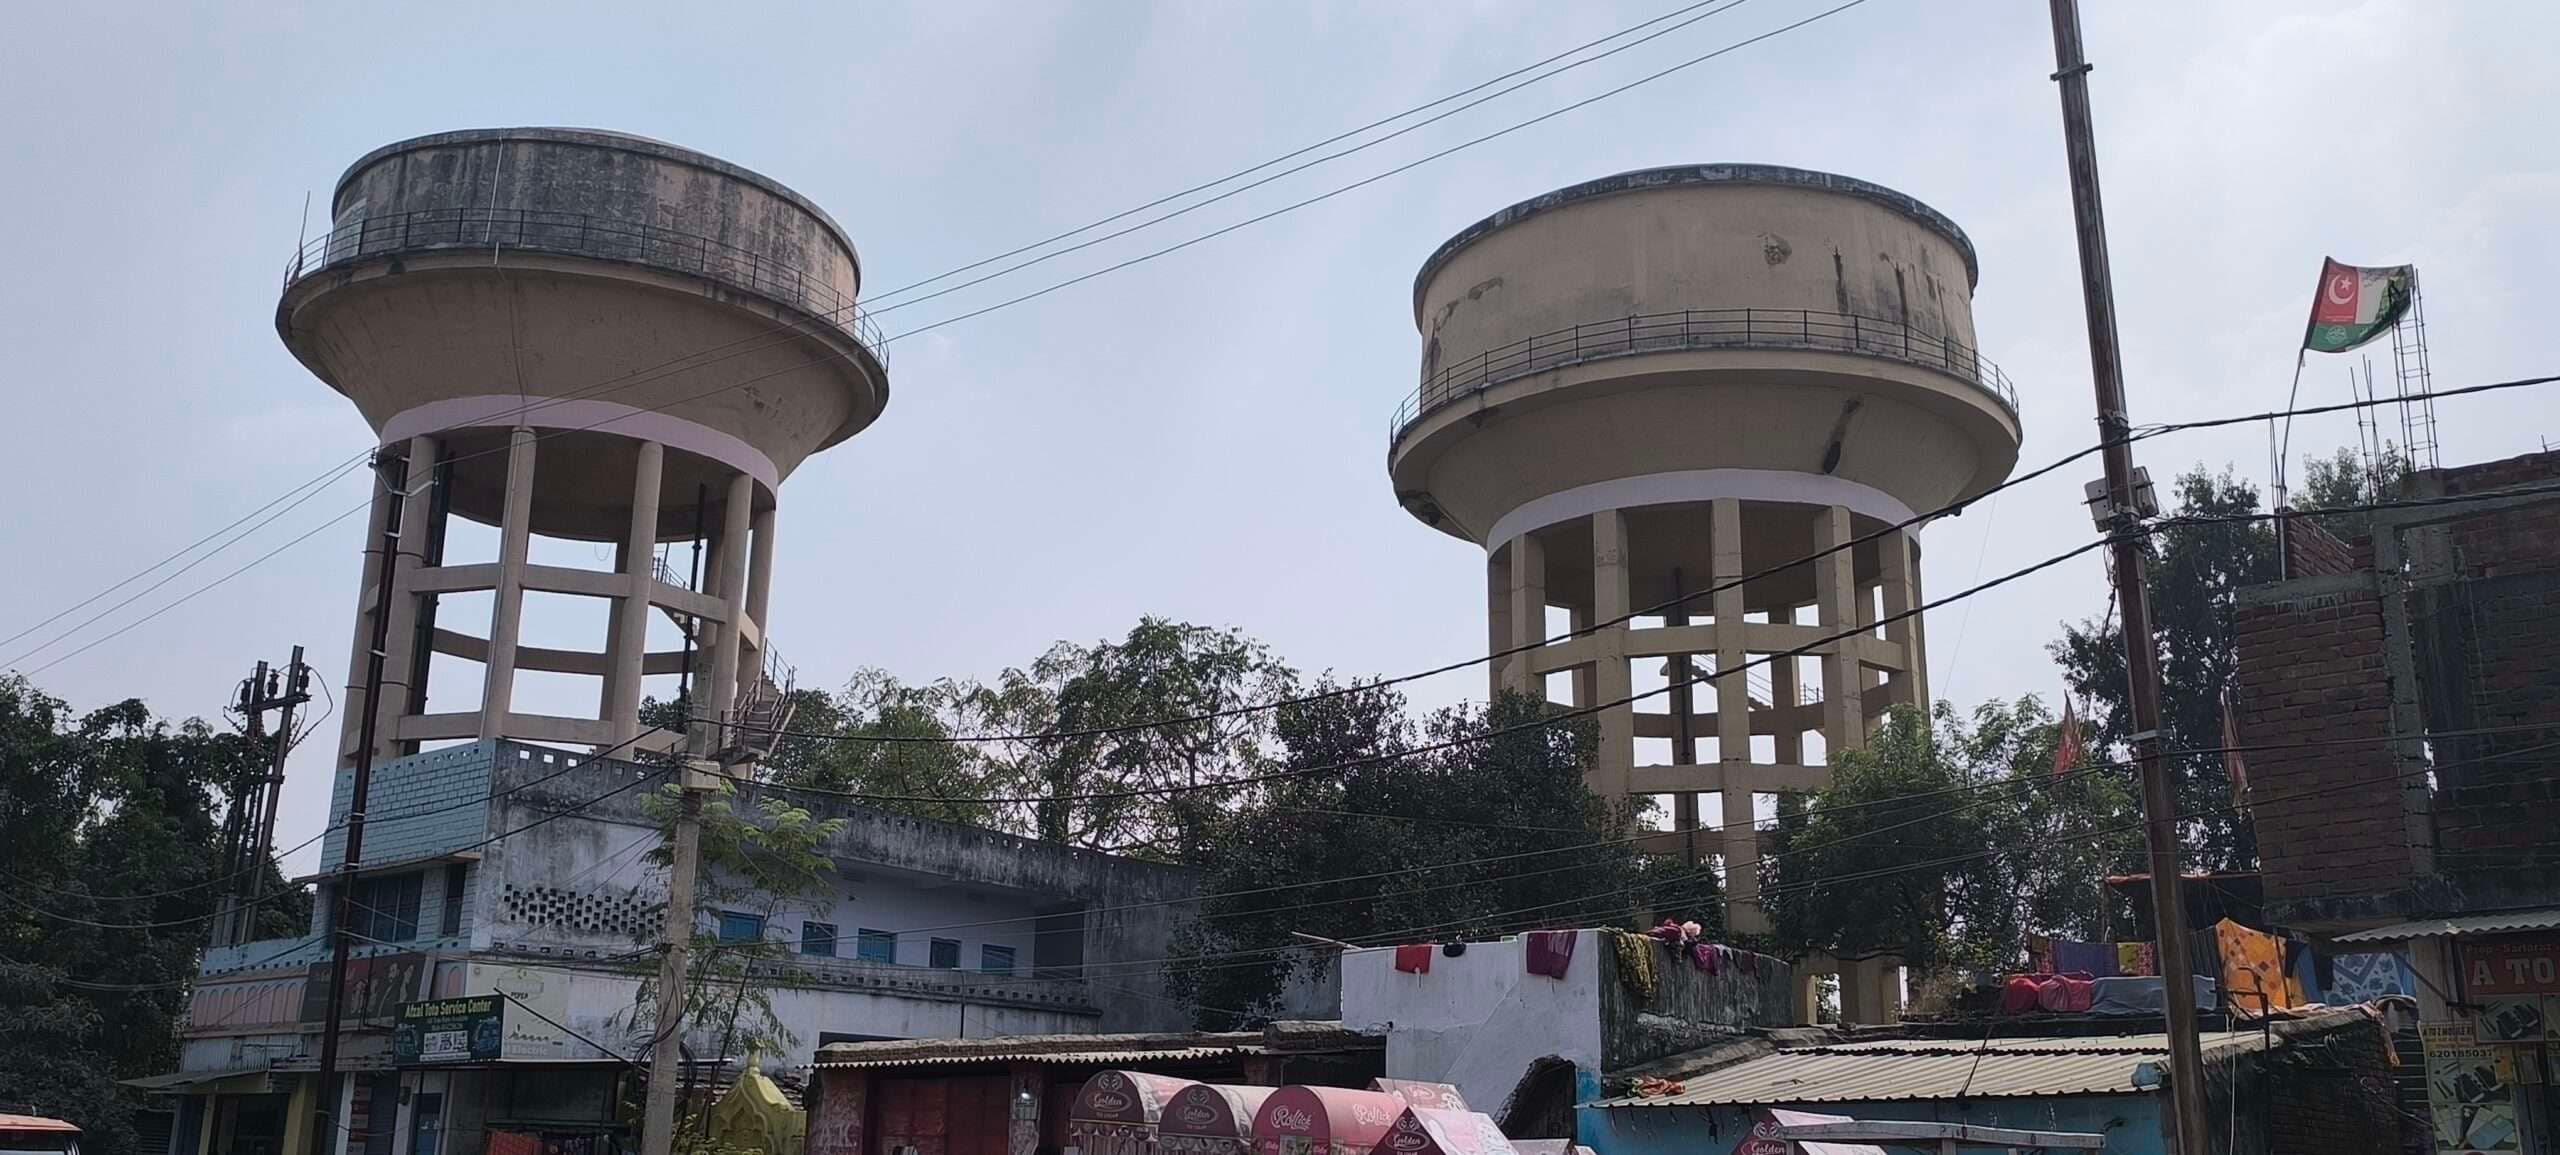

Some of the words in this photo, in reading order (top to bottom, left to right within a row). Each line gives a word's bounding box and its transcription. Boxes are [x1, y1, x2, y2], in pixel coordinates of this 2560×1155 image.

[2472, 959, 2496, 985] A
[2504, 957, 2556, 985] TO
[440, 1000, 467, 1016] Service
[468, 998, 492, 1013] Center
[1093, 1093, 1122, 1107] Golden
[1393, 1134, 1421, 1148] Golden
